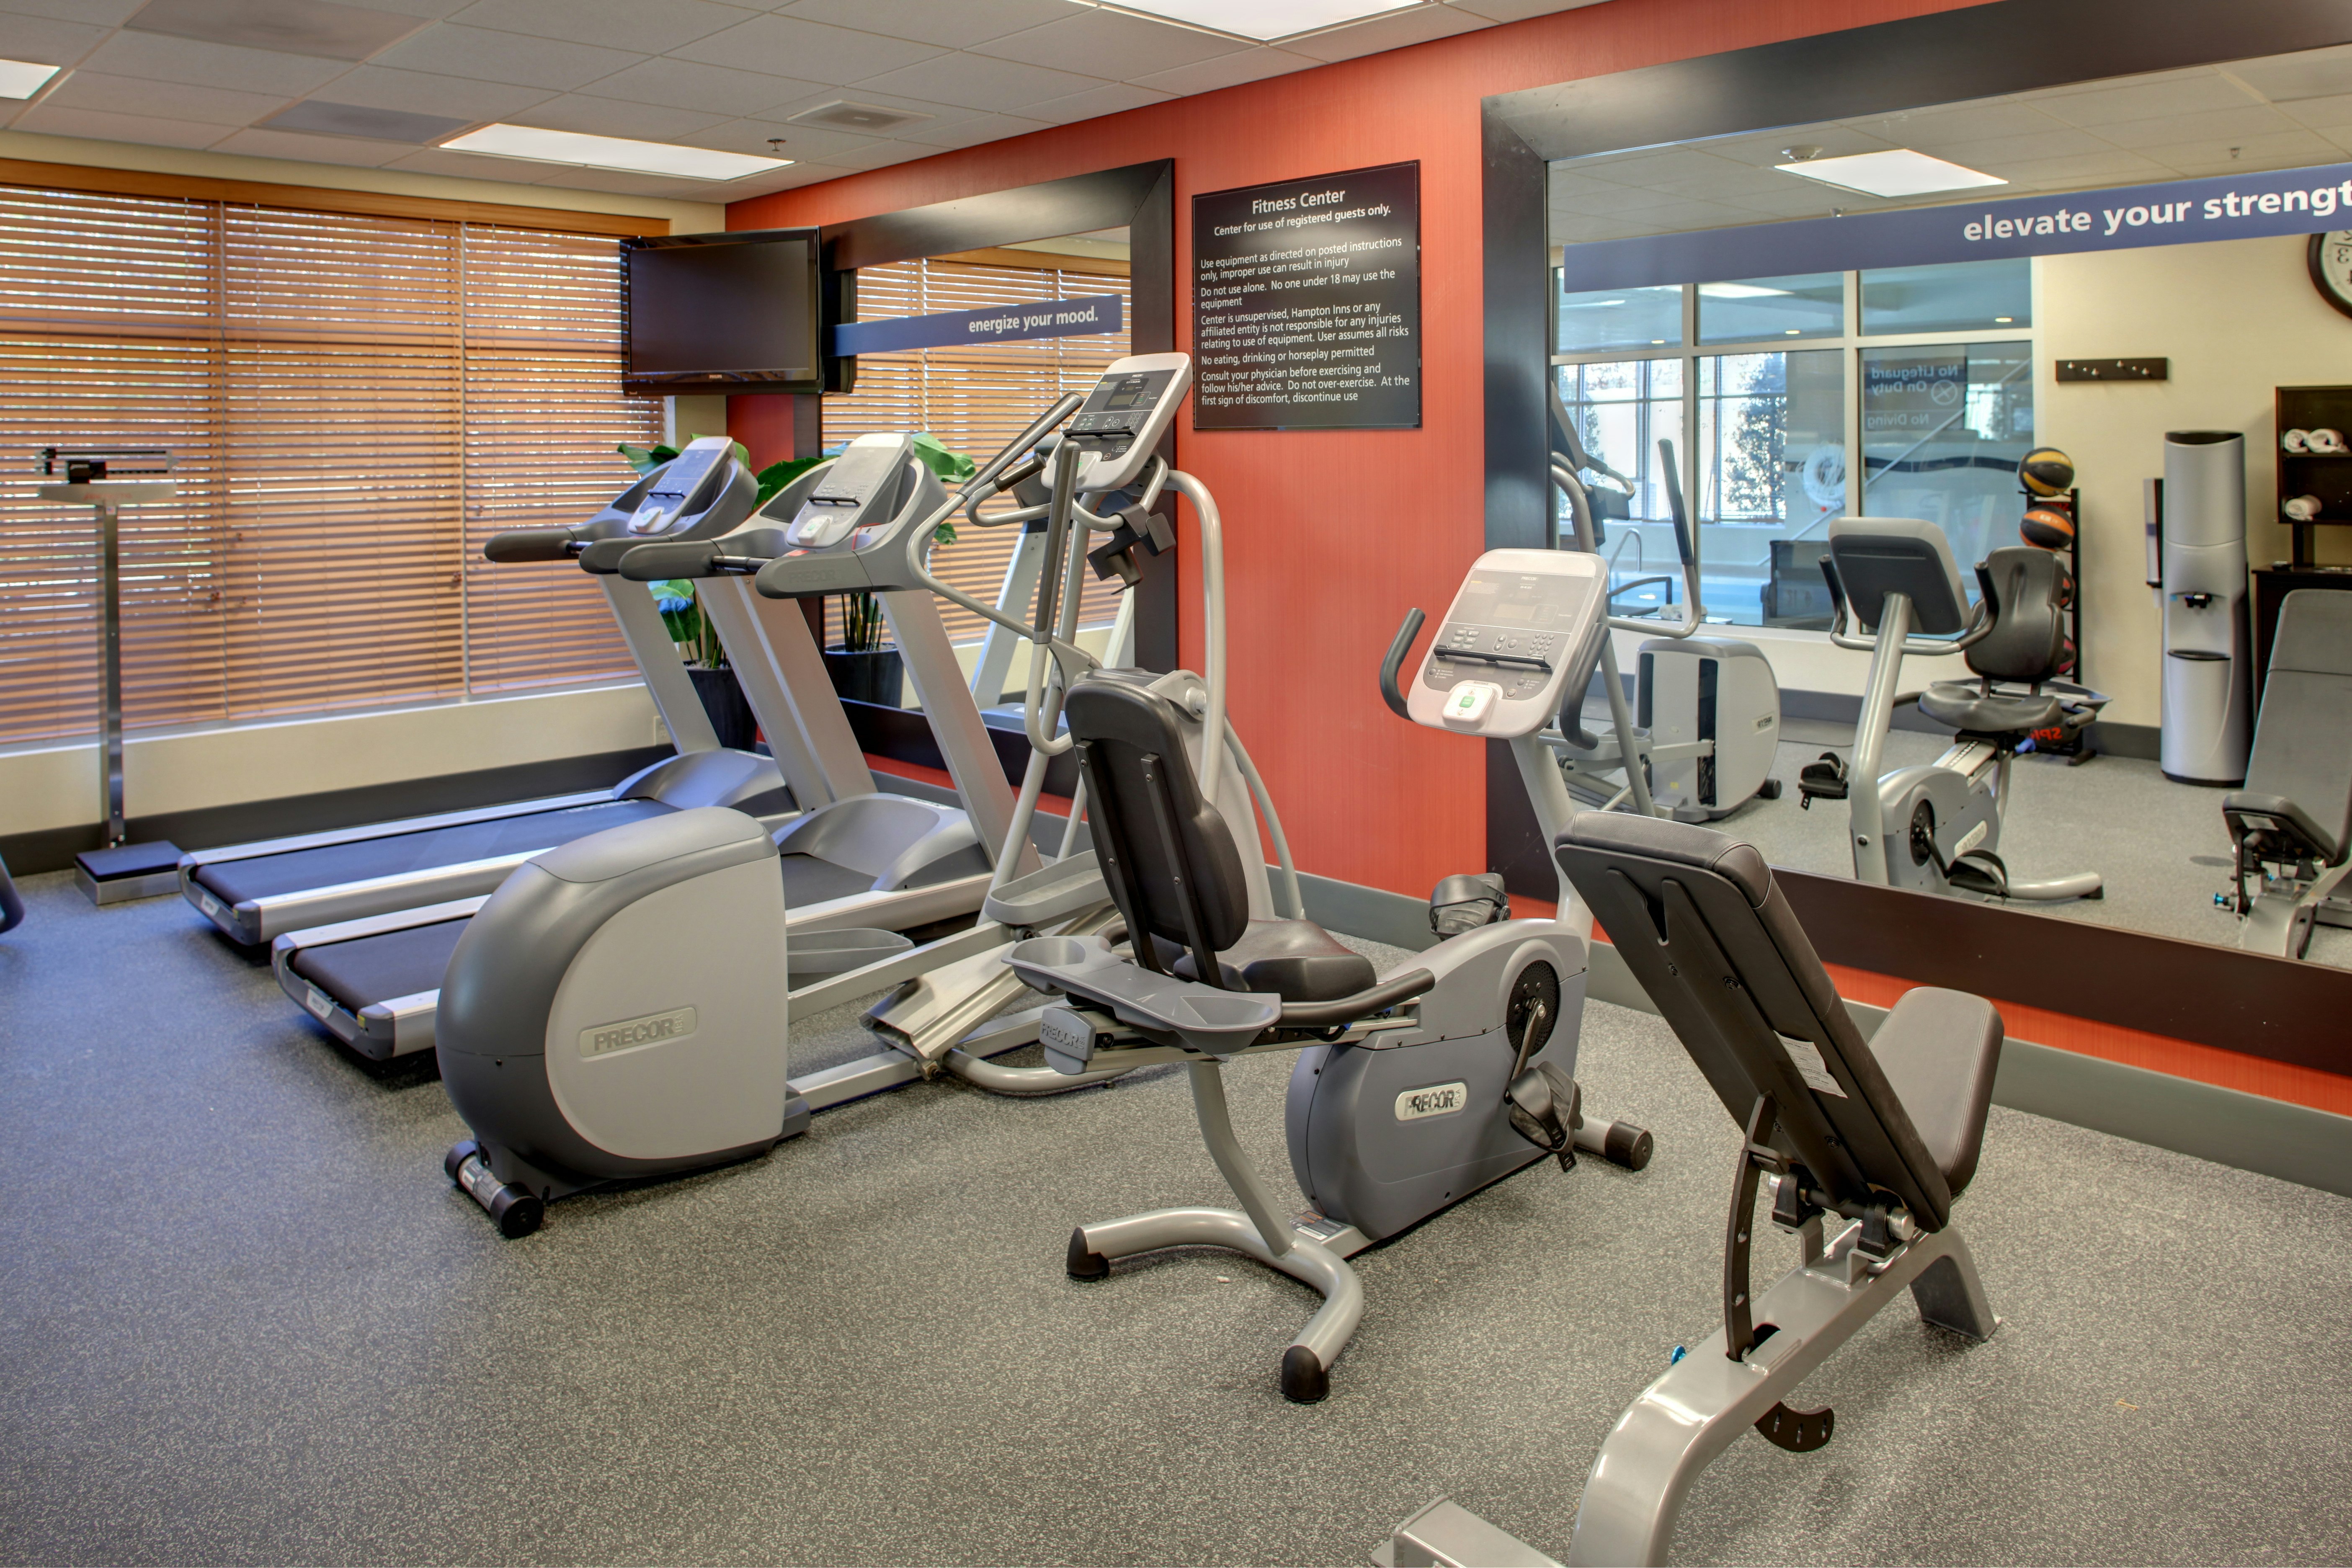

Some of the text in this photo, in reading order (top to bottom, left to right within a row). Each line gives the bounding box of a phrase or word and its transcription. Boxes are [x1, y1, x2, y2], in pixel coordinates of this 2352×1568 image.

[1252, 190, 1346, 214] Fitness Center
[1214, 203, 1391, 236] Center for use of registered guests only.
[1964, 209, 2092, 241] elevate
[2103, 201, 2192, 236] your
[1201, 237, 1402, 269] Use equipment as directed on posted instructions
[1200, 257, 1349, 282] only, improper use can result in injury
[1201, 268, 1395, 297] Do not use alone. No one under 18 may use the
[1201, 297, 1243, 311] equipment
[1201, 303, 1381, 325] Center is unsupervised, Hampton Inns or any
[969, 305, 1099, 334] energize your mood.
[1201, 313, 1401, 337] affiliated entity is not responsible for any injuries
[1201, 325, 1409, 350] relating to use of equipment. User assumes all risks
[1201, 345, 1375, 366] No eating, drinking or horseplay permitted
[1201, 362, 1381, 382] Consult your physician before exercising and
[1201, 374, 1410, 393] follow his/her advice. Do not over-exercise. At the
[1201, 391, 1358, 407] first sign of discomfort, discontinue use
[594, 1017, 675, 1051] PRECOR
[1042, 1024, 1079, 1049] PRECOR
[1404, 1089, 1454, 1116] PRECOR
